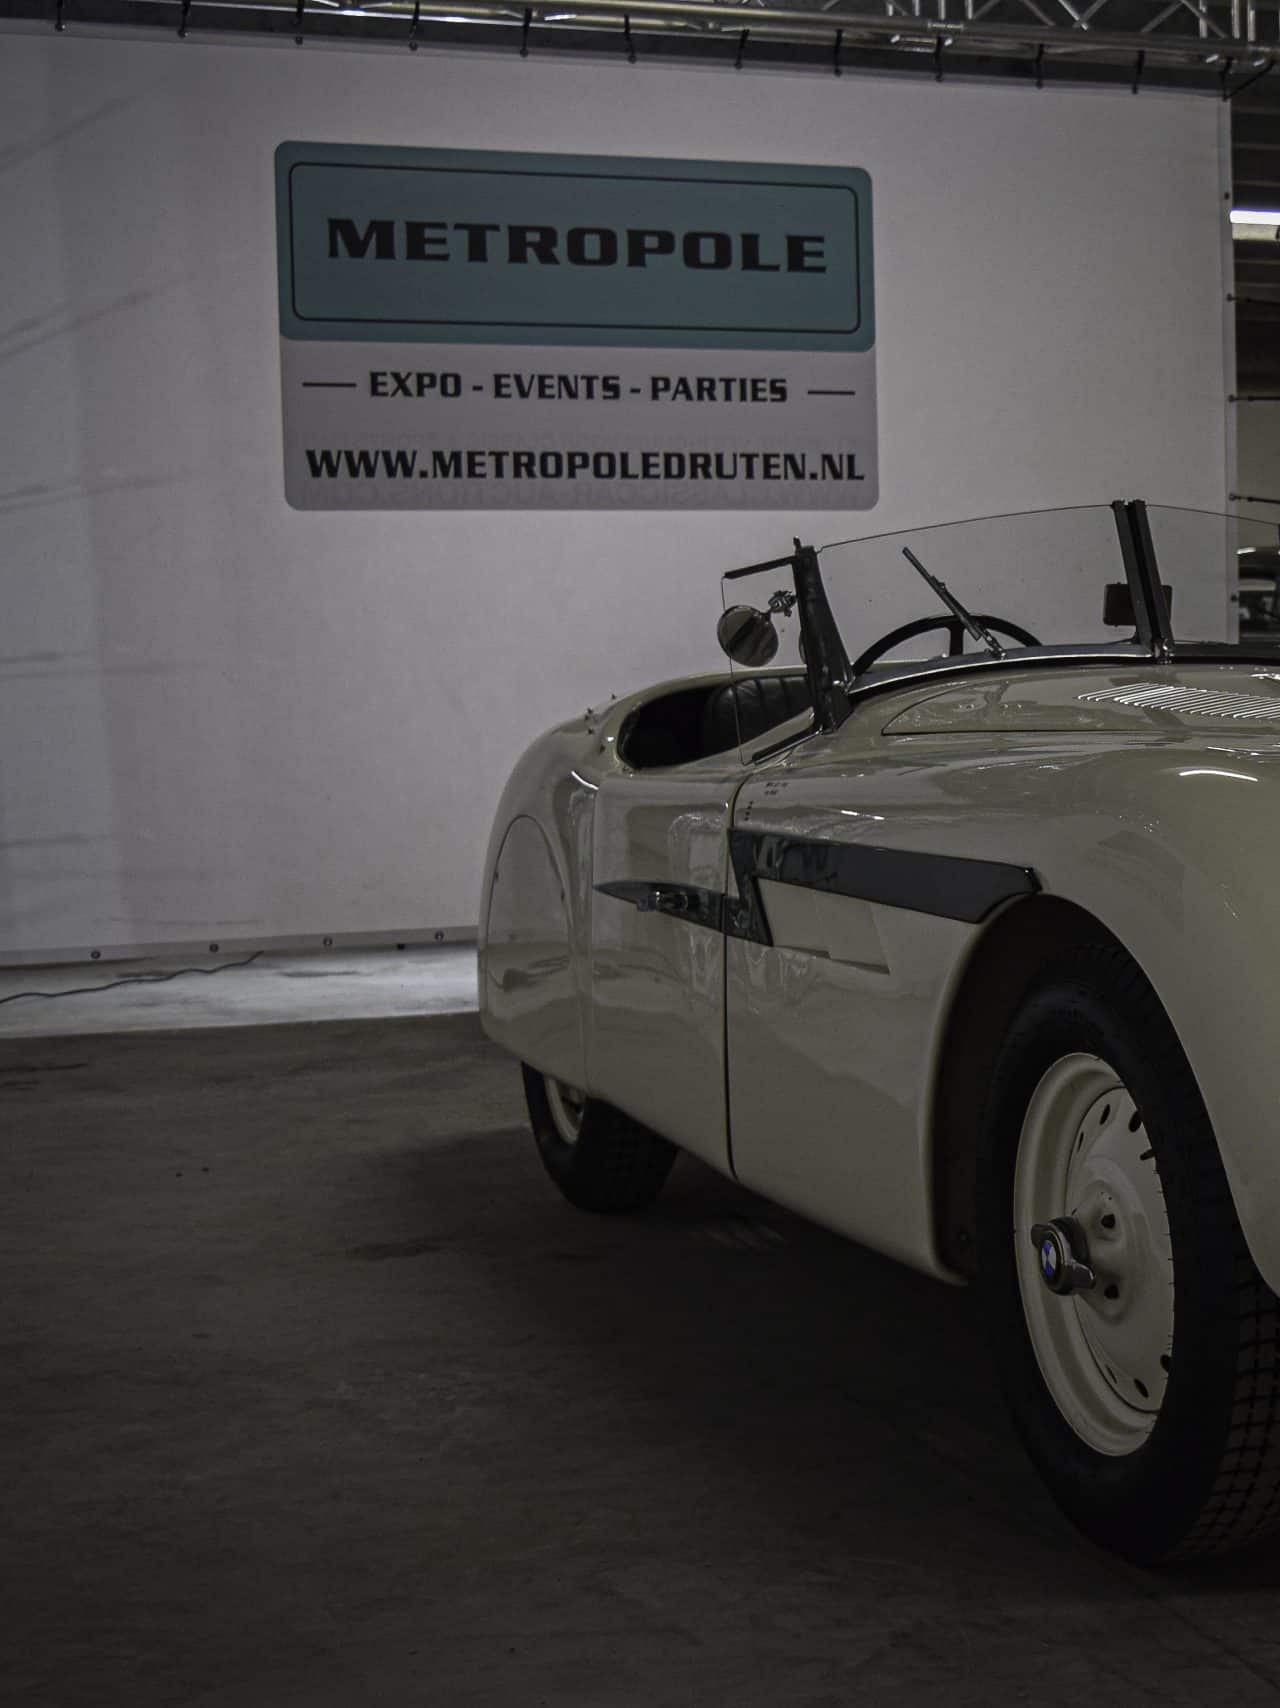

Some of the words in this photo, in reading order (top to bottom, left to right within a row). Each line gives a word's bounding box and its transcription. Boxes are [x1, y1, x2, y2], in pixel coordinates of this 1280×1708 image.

[327, 218, 827, 273] METROPOLE
[369, 371, 461, 398] EXPO
[493, 374, 621, 400] EVENTS
[651, 376, 788, 402] PARTIES
[305, 449, 865, 480] WWW.METROPOLEDRUTEN.NL
